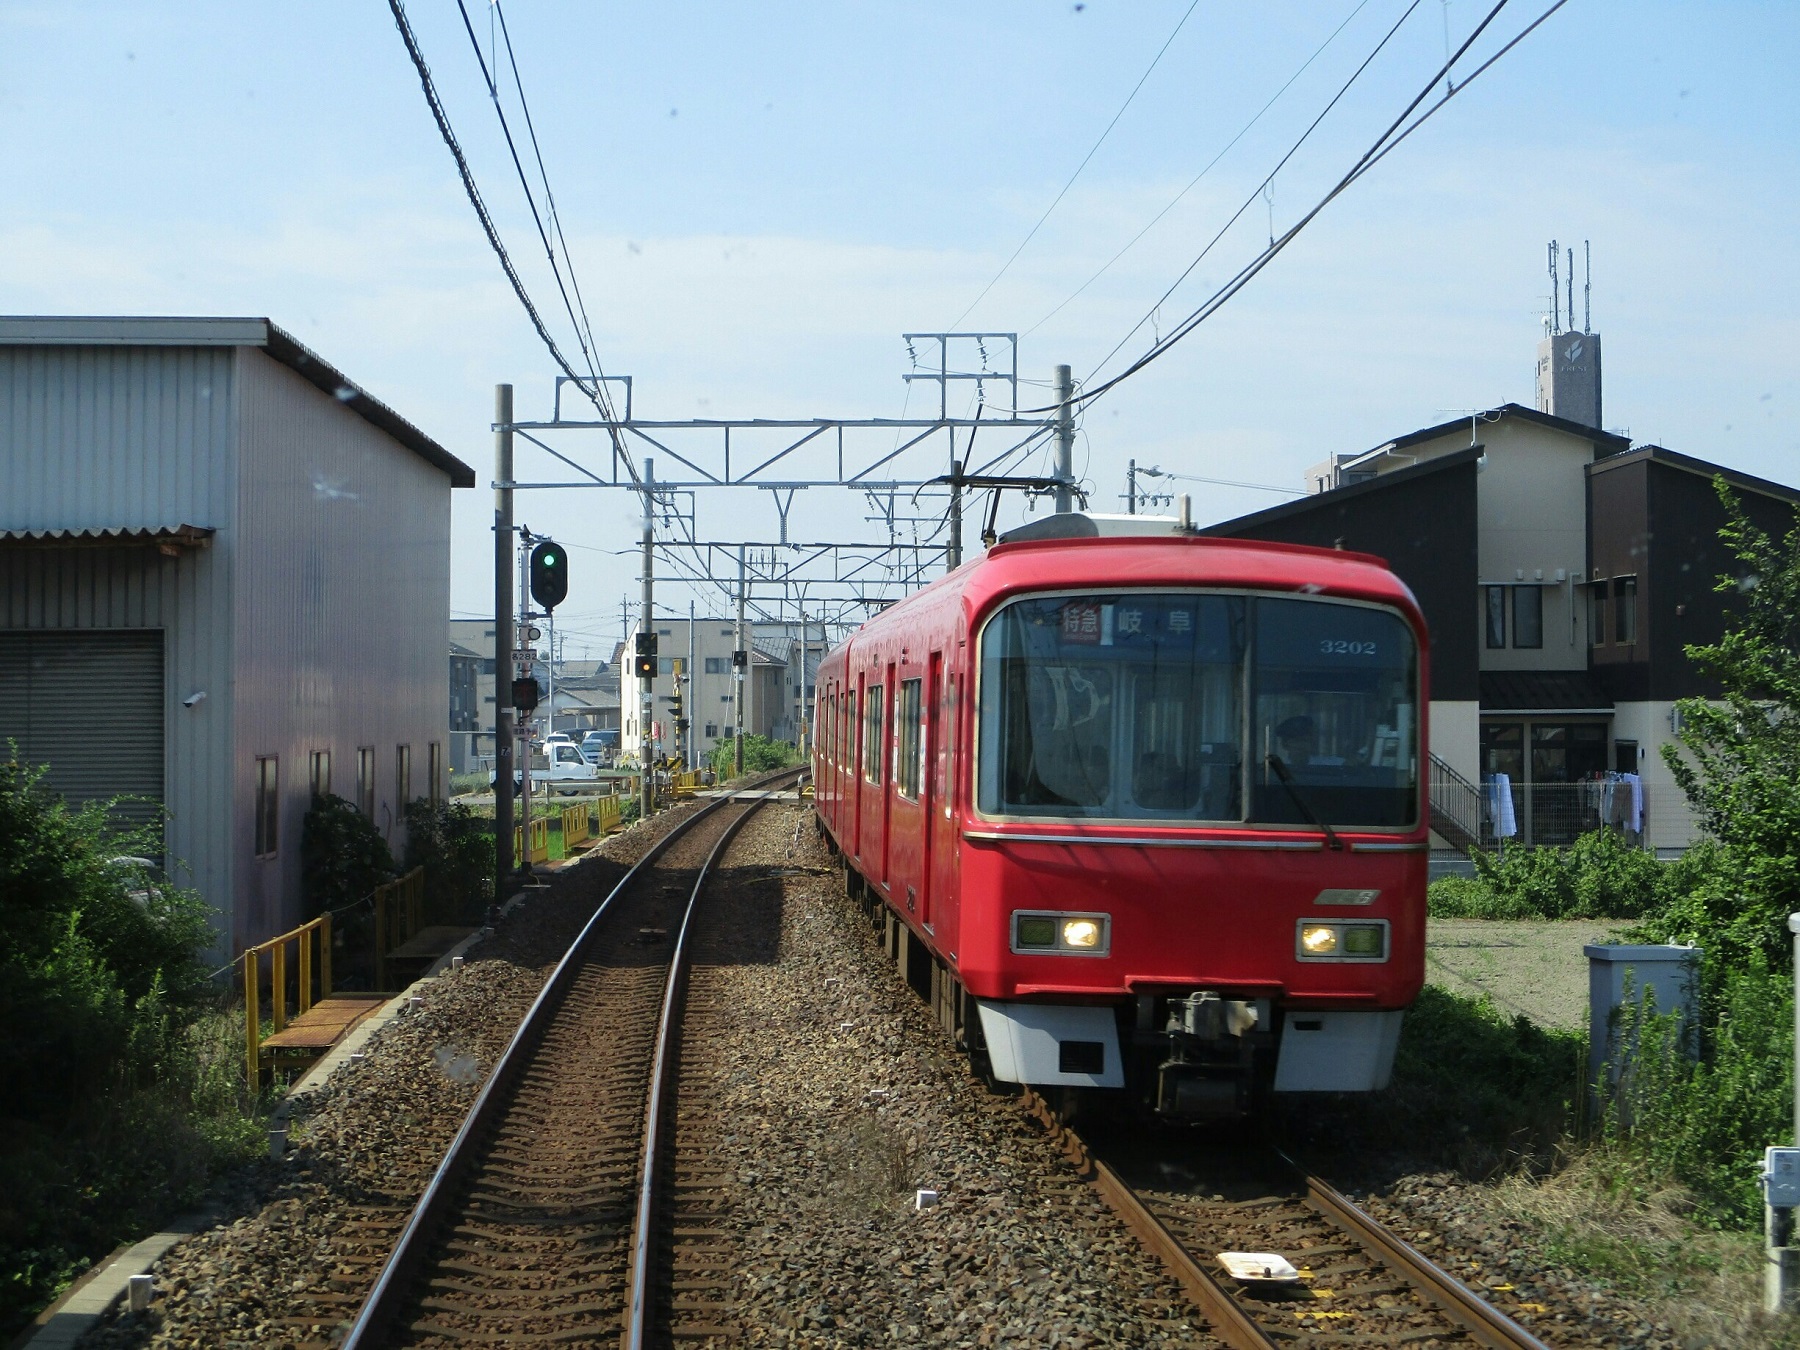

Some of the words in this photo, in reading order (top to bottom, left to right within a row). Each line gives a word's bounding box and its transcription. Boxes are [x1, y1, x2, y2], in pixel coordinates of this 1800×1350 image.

[1063, 608, 1098, 633] 特急
[1118, 608, 1192, 634] 岐阜
[1320, 639, 1377, 655] 3202
